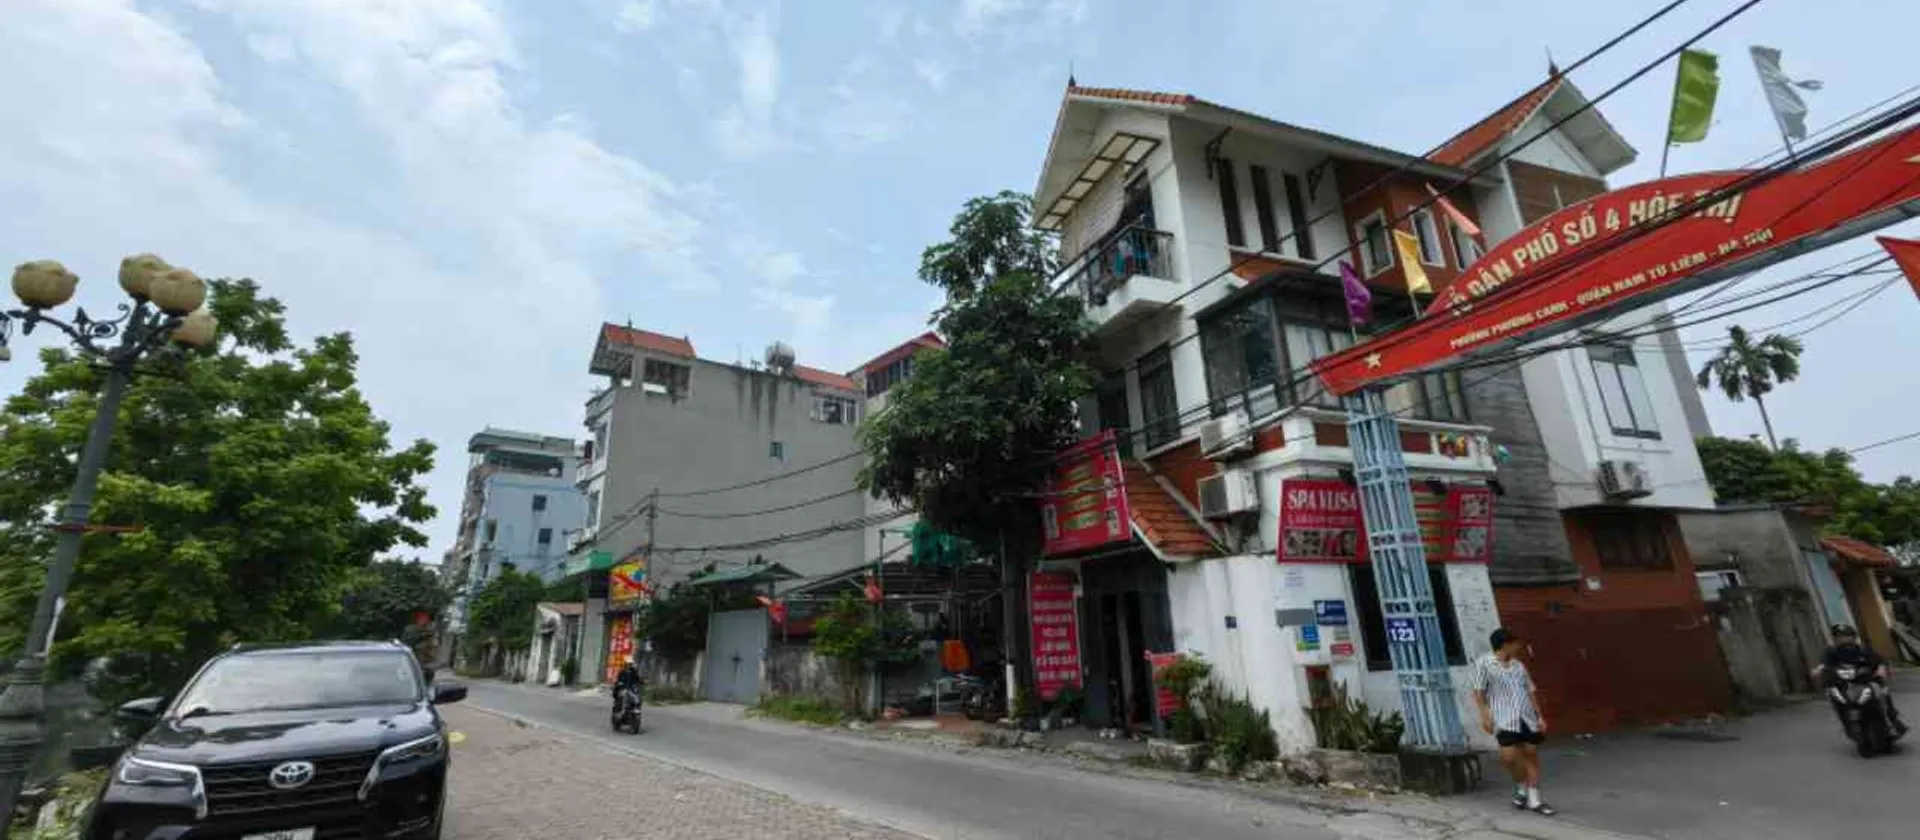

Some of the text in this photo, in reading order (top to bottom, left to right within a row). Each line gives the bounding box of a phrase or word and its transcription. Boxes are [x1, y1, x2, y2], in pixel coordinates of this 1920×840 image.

[1512, 221, 1560, 269] PHỐ
[1562, 203, 1598, 246] SỐ
[1604, 207, 1622, 231] 4
[1613, 272, 1646, 292] NAM
[1670, 250, 1708, 273] LIÊM
[1287, 488, 1317, 511] SPA
